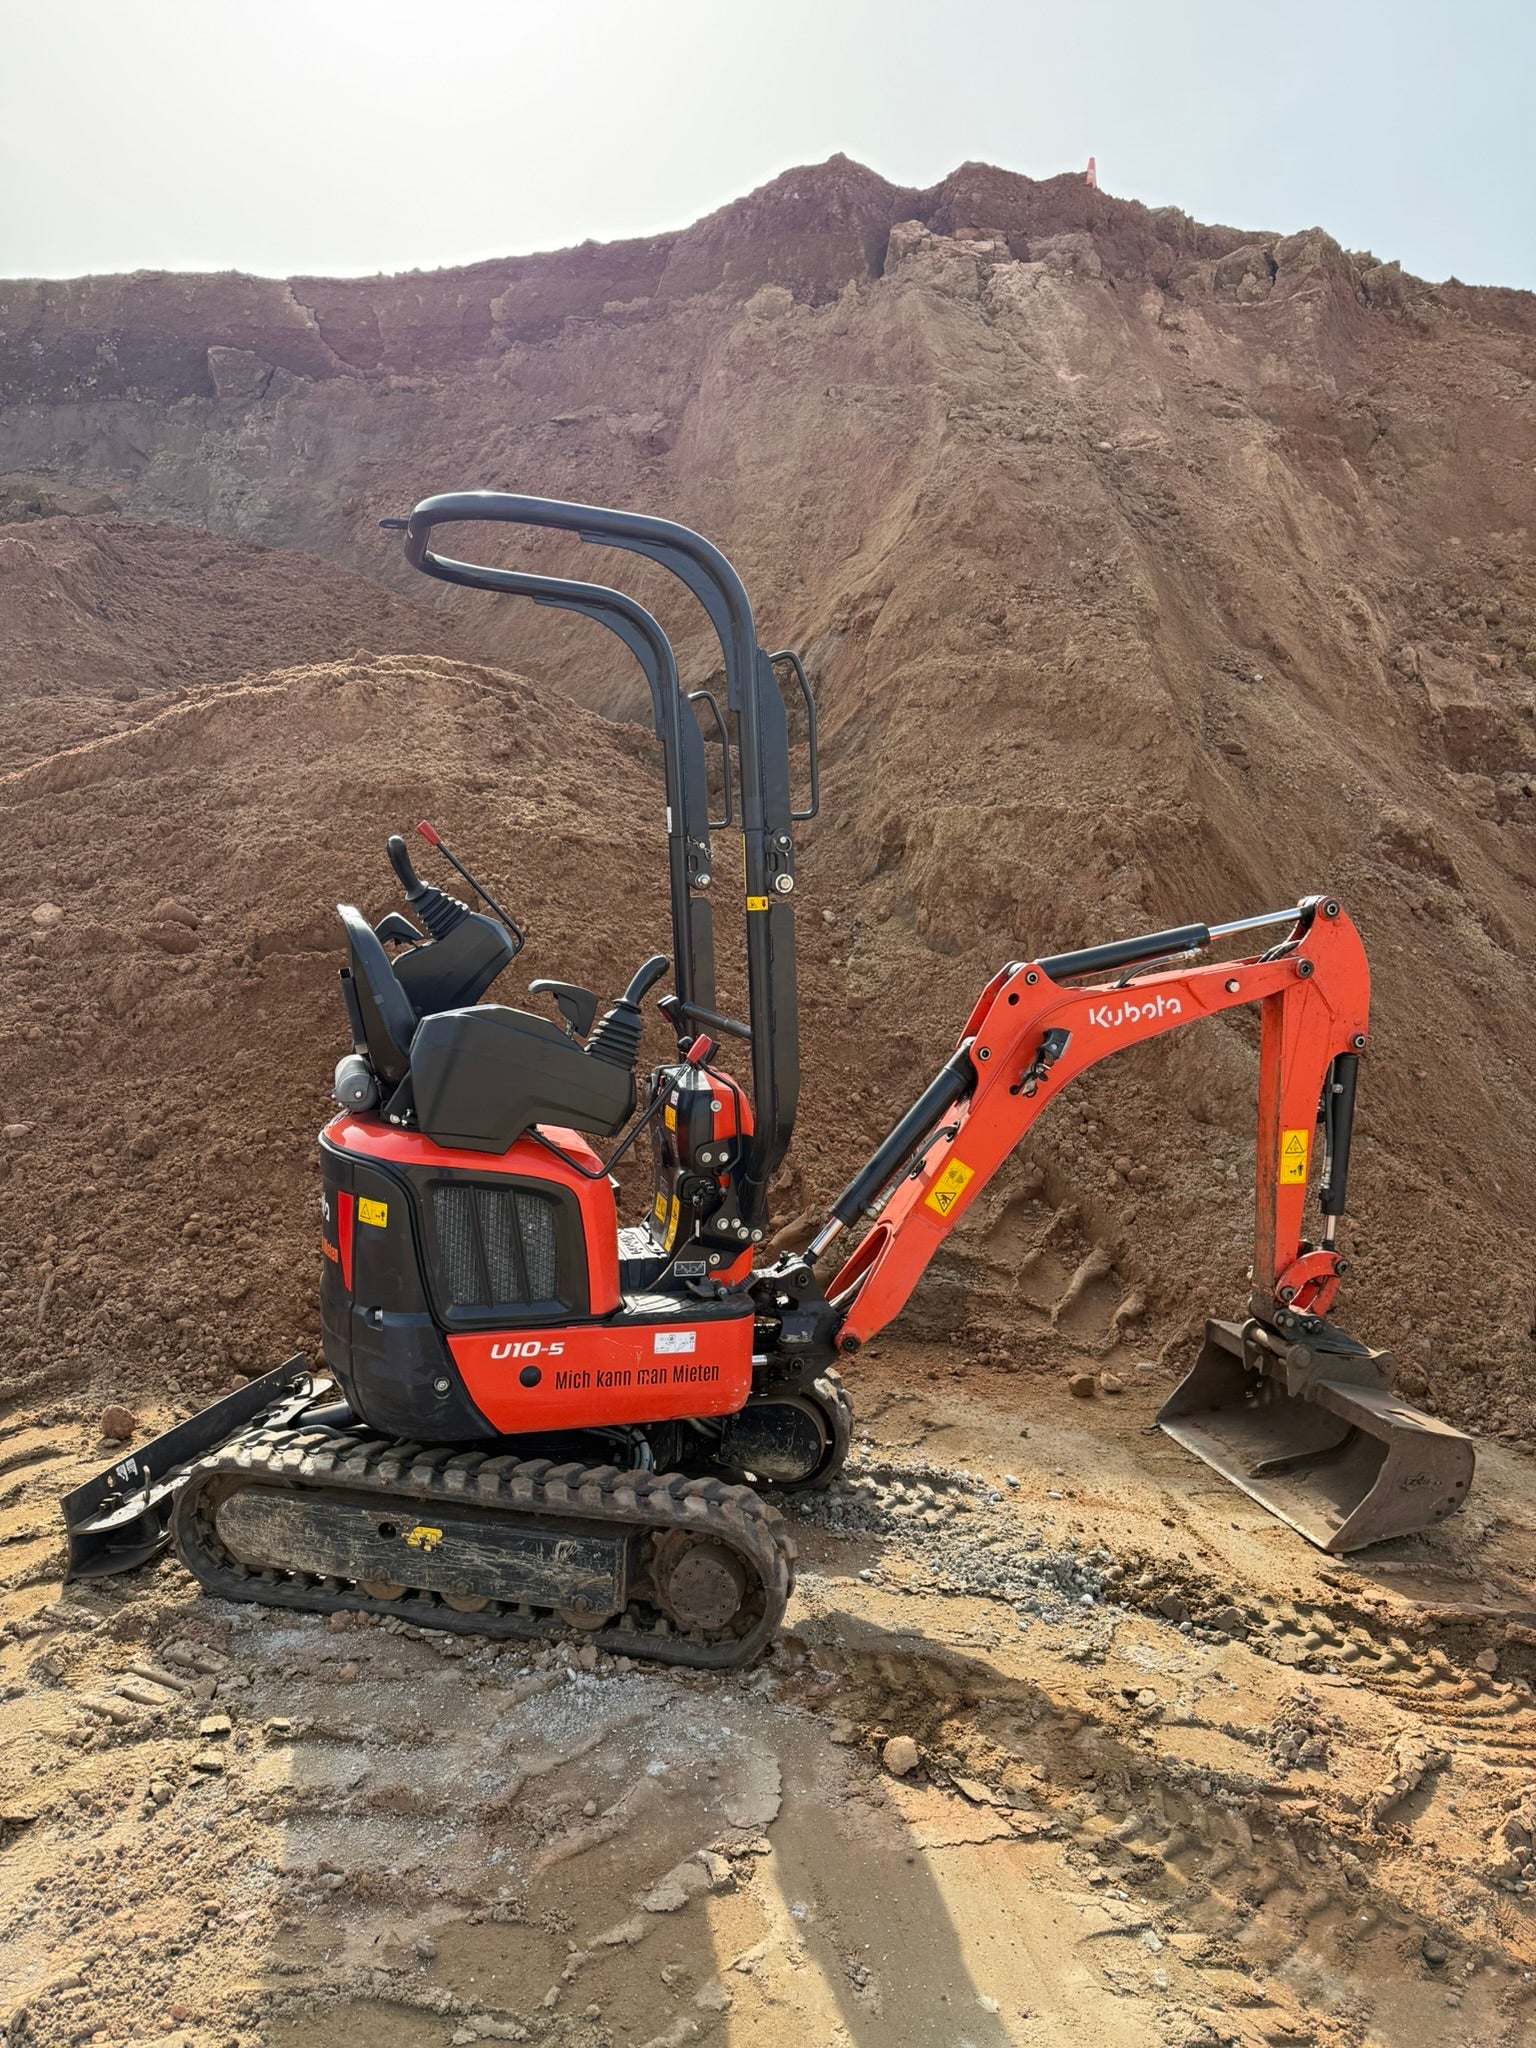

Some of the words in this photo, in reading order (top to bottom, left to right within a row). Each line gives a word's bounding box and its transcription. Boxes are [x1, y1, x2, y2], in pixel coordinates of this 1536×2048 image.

[1089, 995, 1181, 1028] Kubota
[490, 1341, 565, 1359] U10-5
[555, 1370, 590, 1389] Mich
[596, 1369, 631, 1388] kann
[637, 1366, 667, 1385] man
[672, 1364, 719, 1383] Mieten
